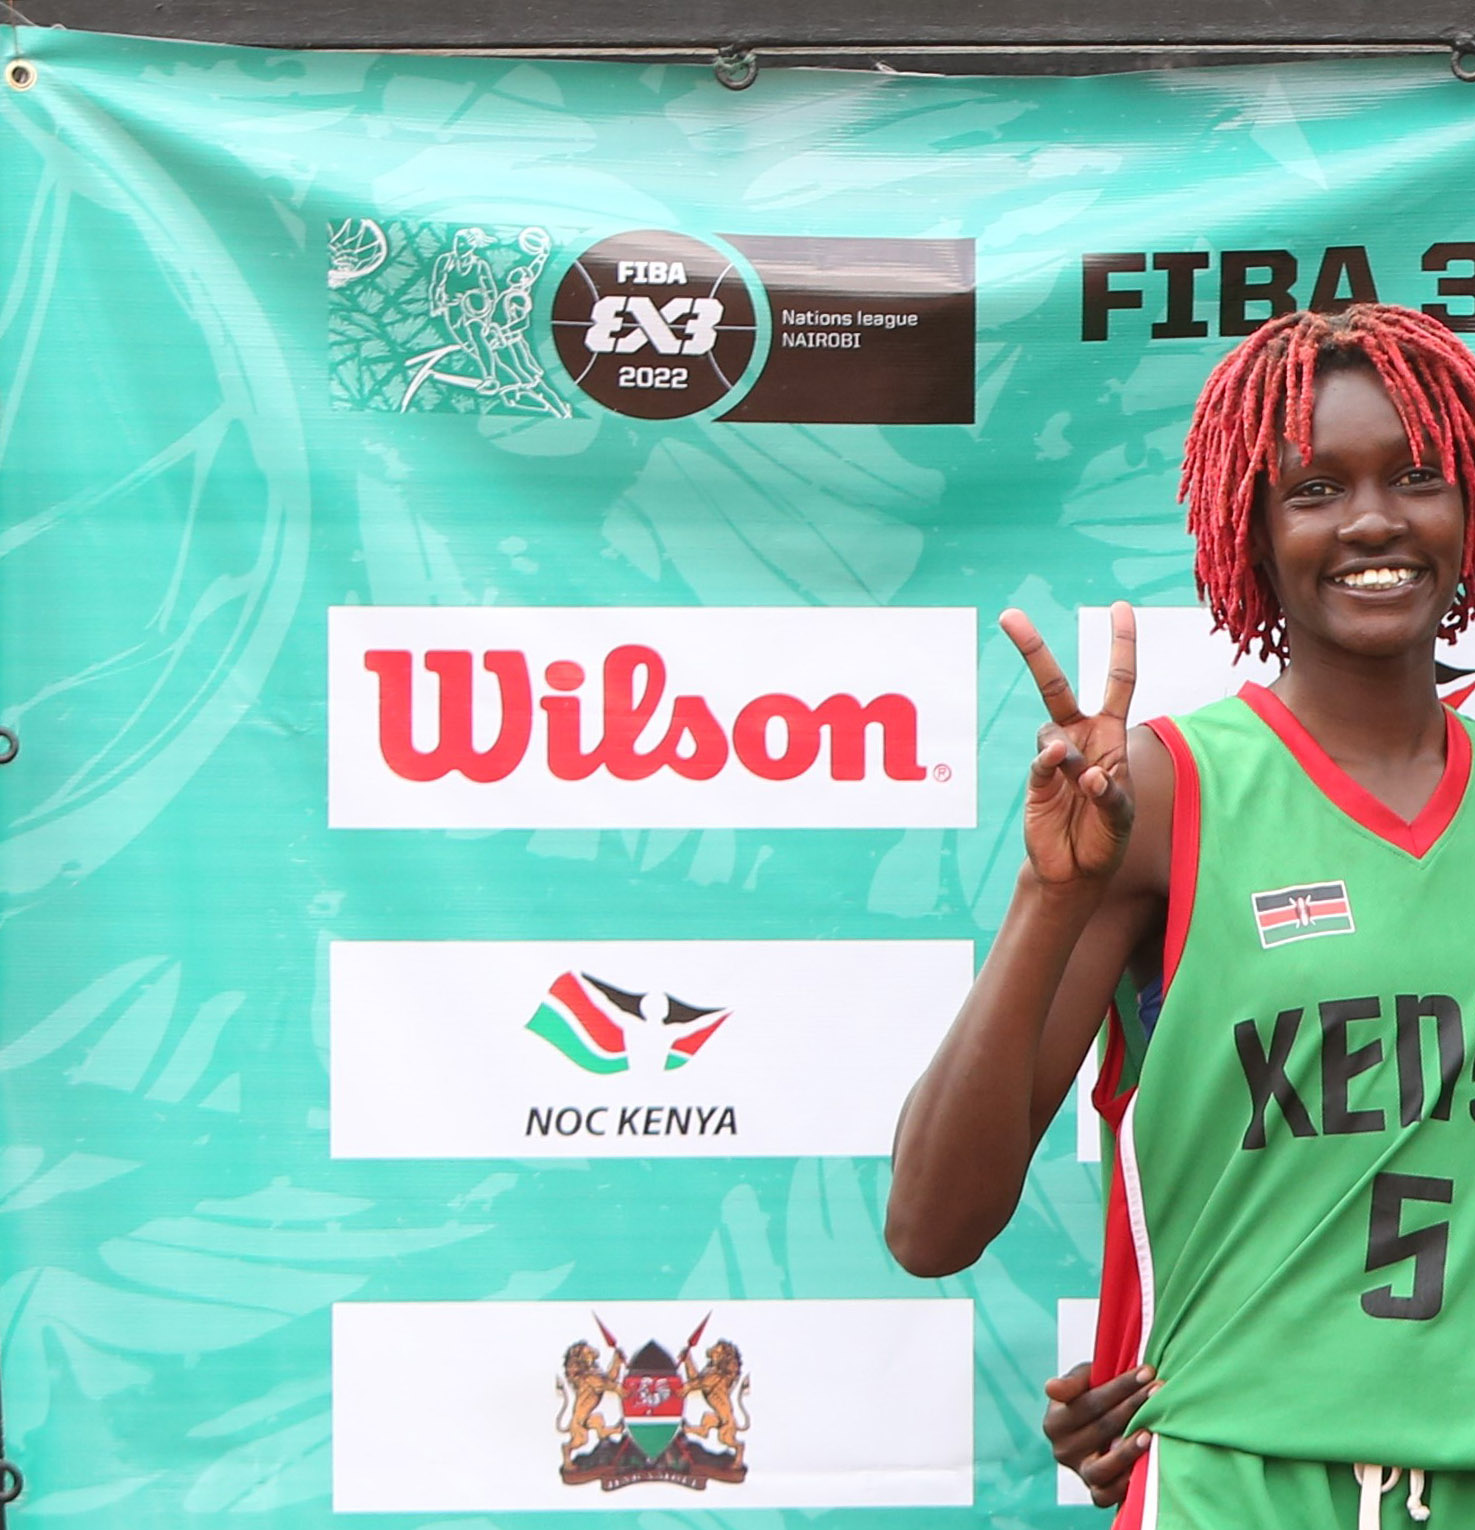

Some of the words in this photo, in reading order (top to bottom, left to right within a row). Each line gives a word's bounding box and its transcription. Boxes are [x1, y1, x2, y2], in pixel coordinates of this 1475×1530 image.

[617, 260, 687, 286] FIBA
[1080, 245, 1380, 342] FIBA
[781, 309, 853, 326] Nations
[856, 310, 919, 330] league
[781, 332, 862, 349] NAIROBI
[618, 365, 689, 390] 2022
[364, 644, 928, 784] Wilson
[524, 1106, 608, 1137] NOC
[616, 1105, 739, 1137] KENYA
[1360, 1171, 1454, 1322] 5
